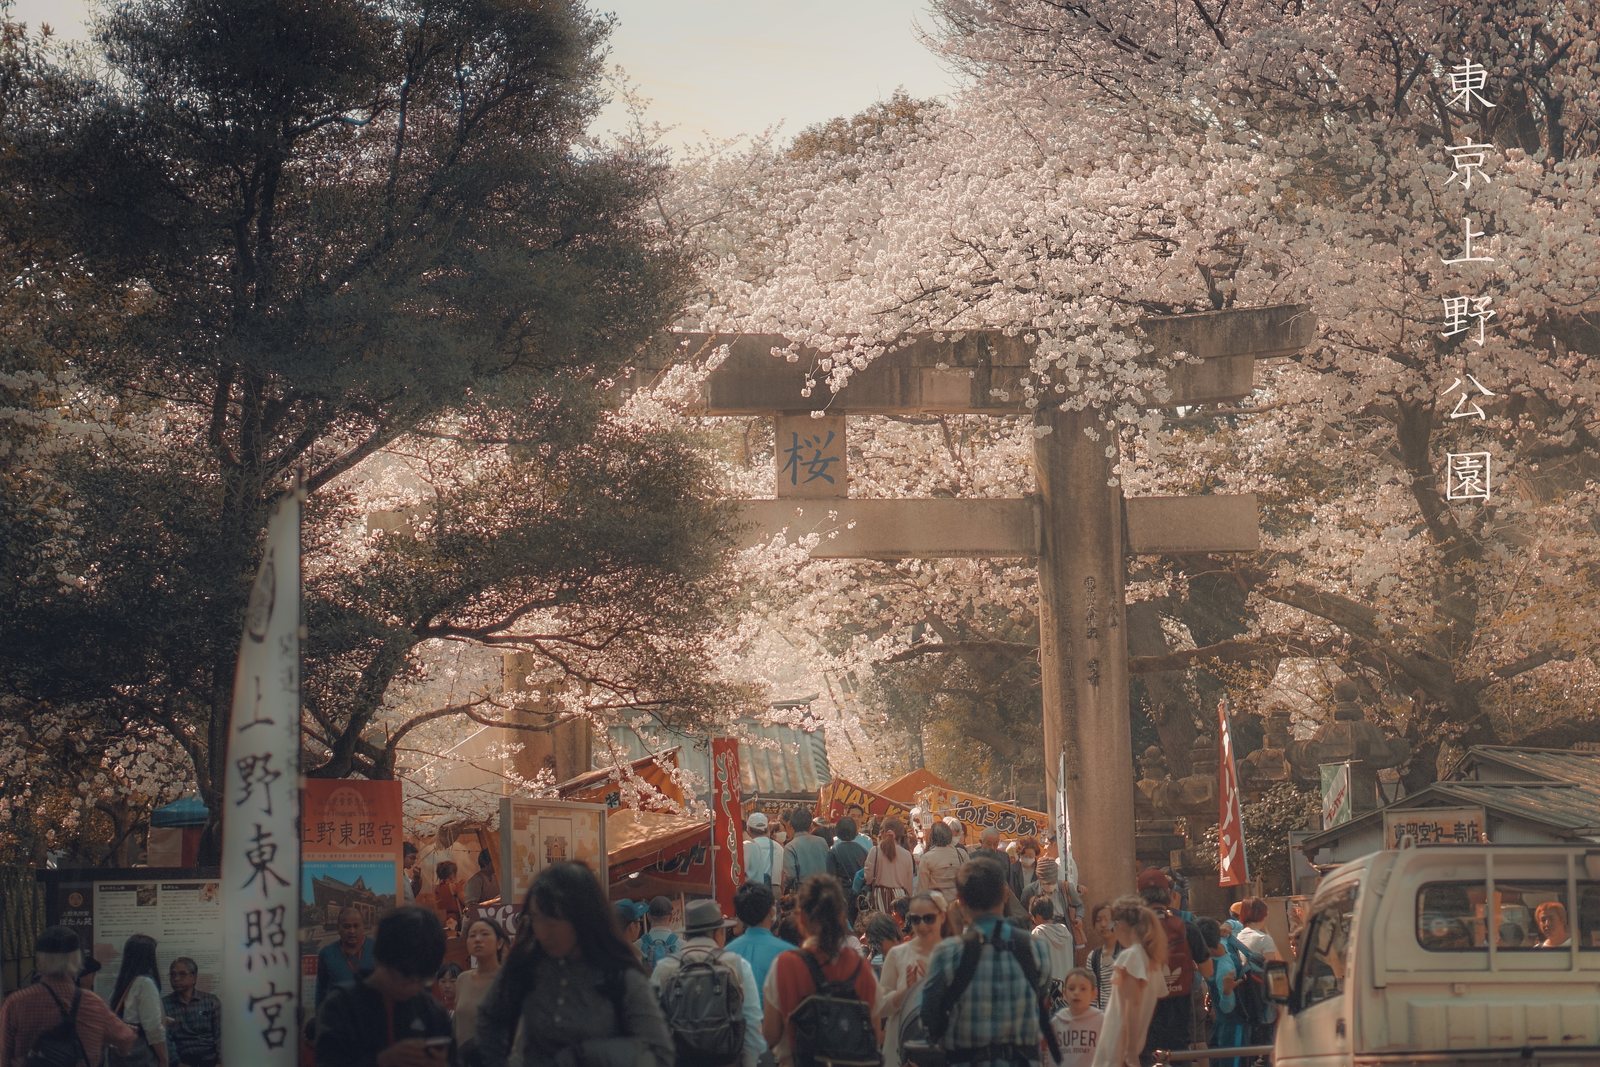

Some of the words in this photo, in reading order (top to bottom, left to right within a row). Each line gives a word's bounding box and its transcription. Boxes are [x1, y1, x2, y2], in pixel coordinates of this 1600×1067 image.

[782, 430, 839, 486] 桜
[303, 821, 395, 847] 上野東照宮
[956, 799, 1038, 838] わたあめ
[236, 676, 294, 1051] 上野東照宮
[1056, 1030, 1097, 1048] SUPER
